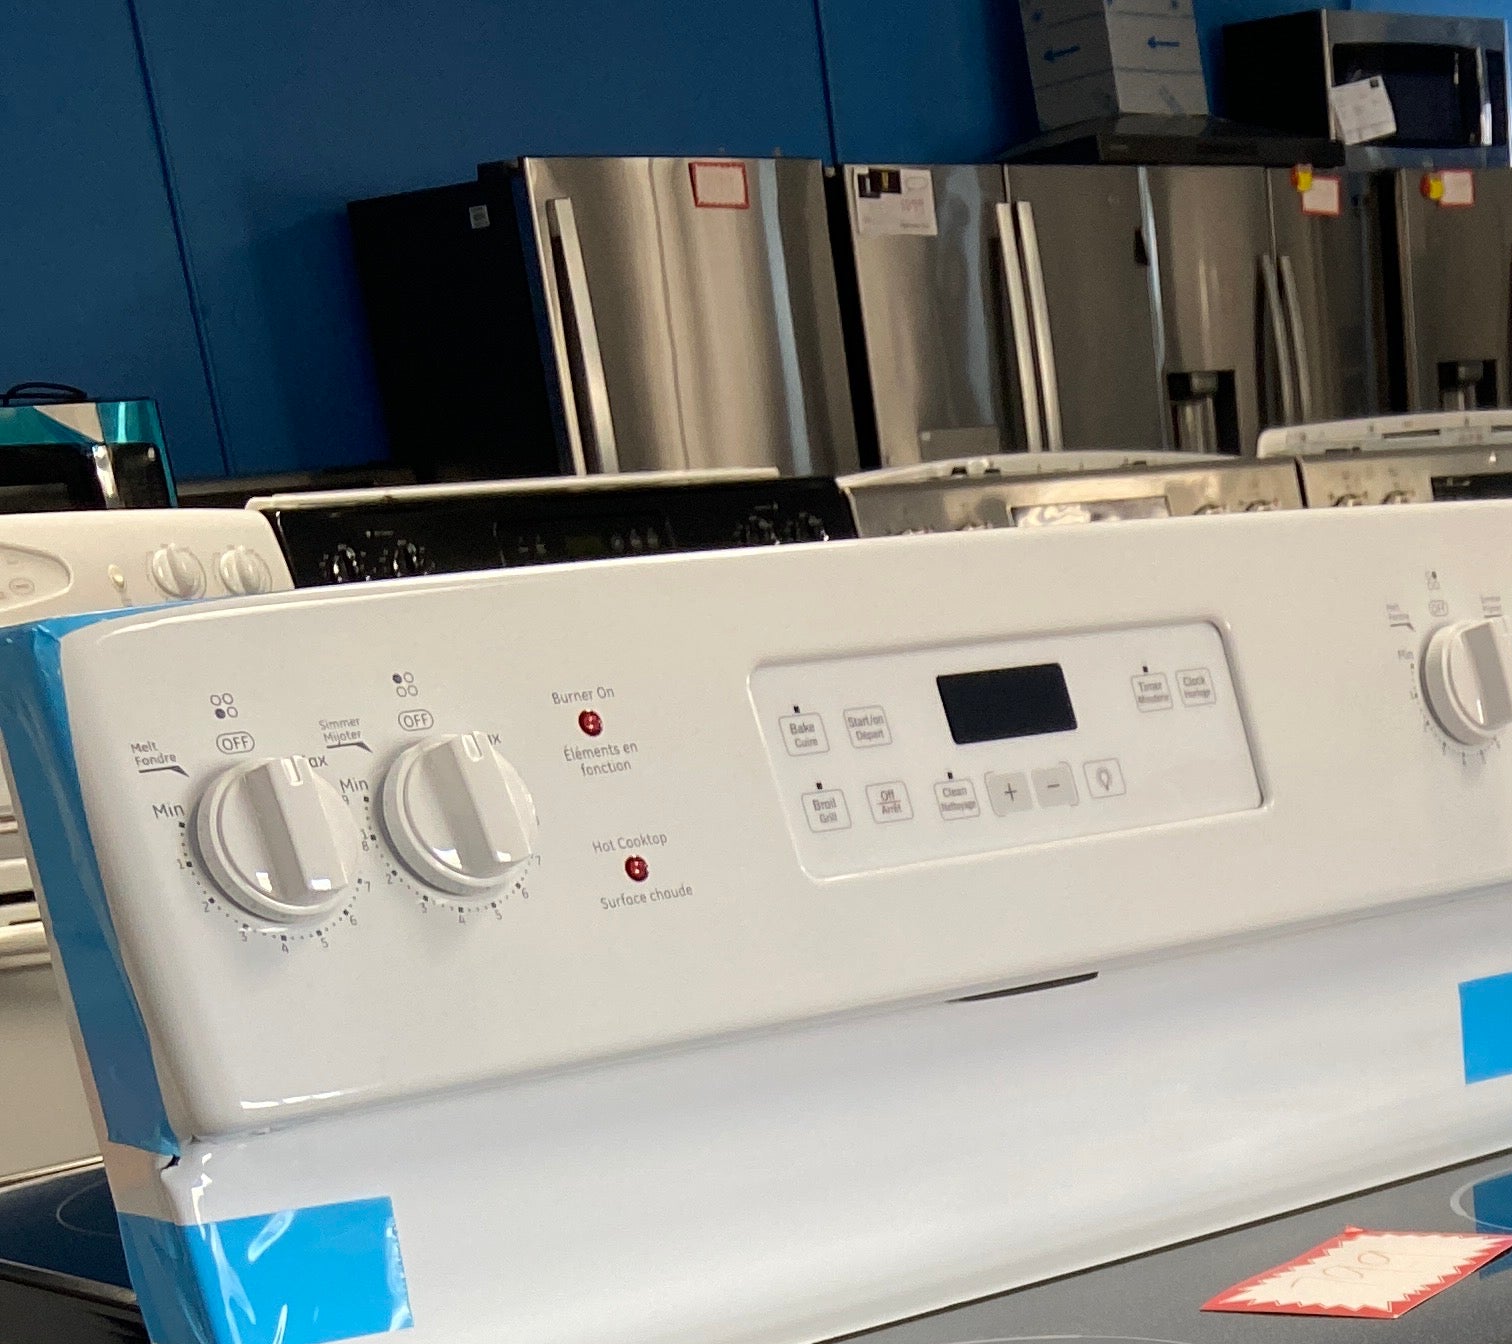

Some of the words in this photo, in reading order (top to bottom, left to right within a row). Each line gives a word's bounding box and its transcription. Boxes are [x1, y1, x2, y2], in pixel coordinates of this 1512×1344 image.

[551, 689, 593, 705] Burner
[596, 686, 615, 699] On
[318, 717, 361, 731] Simmer
[403, 714, 429, 728] OFF
[789, 723, 815, 735] Bake
[221, 735, 249, 750] OFF
[323, 729, 362, 745] Mijoter
[130, 741, 157, 754] Melt
[563, 743, 621, 762] Éléments
[623, 741, 639, 754] en
[134, 752, 177, 766] Fondre
[306, 755, 328, 769] ax
[580, 759, 632, 777] fonction
[340, 778, 369, 794] Min
[152, 803, 184, 819] Min
[591, 839, 616, 854] Hot
[617, 833, 668, 851] Cooktop
[600, 893, 647, 910] Surface
[649, 884, 693, 900] chaude
